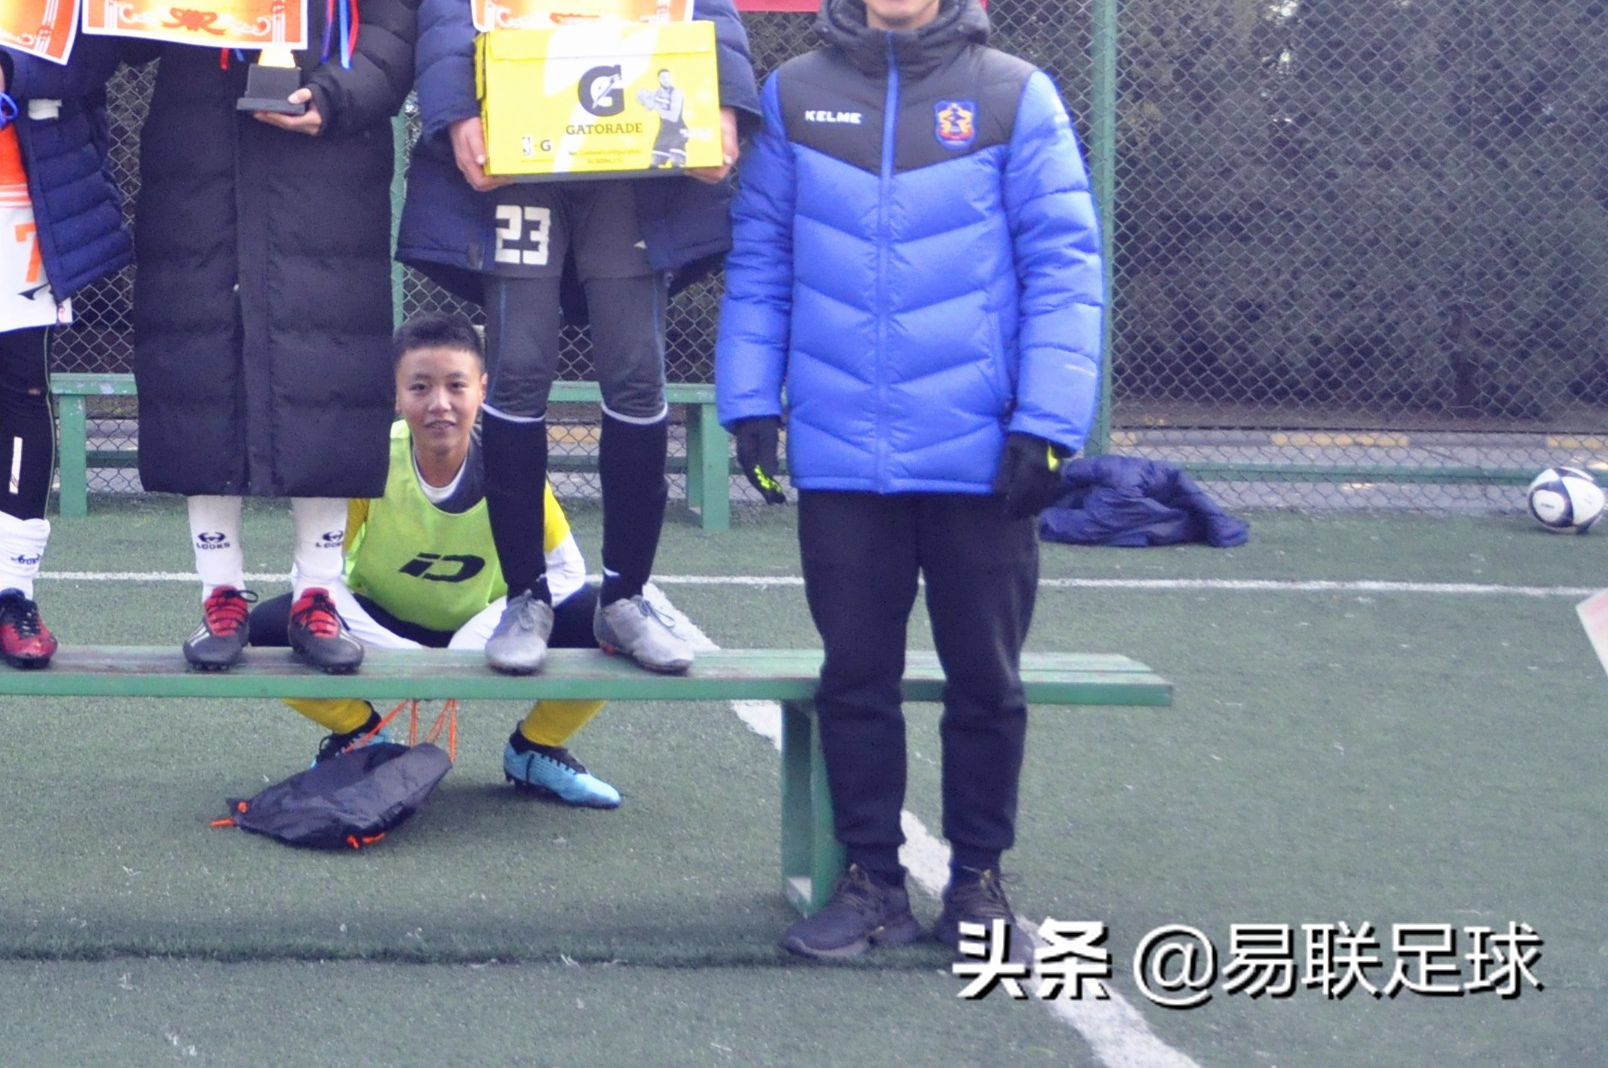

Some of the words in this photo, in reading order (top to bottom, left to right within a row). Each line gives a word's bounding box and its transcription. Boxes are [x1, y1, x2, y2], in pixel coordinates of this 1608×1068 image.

[578, 64, 625, 117] G
[565, 122, 643, 136] GATORADE
[805, 110, 863, 124] KELME
[495, 205, 550, 265] 23
